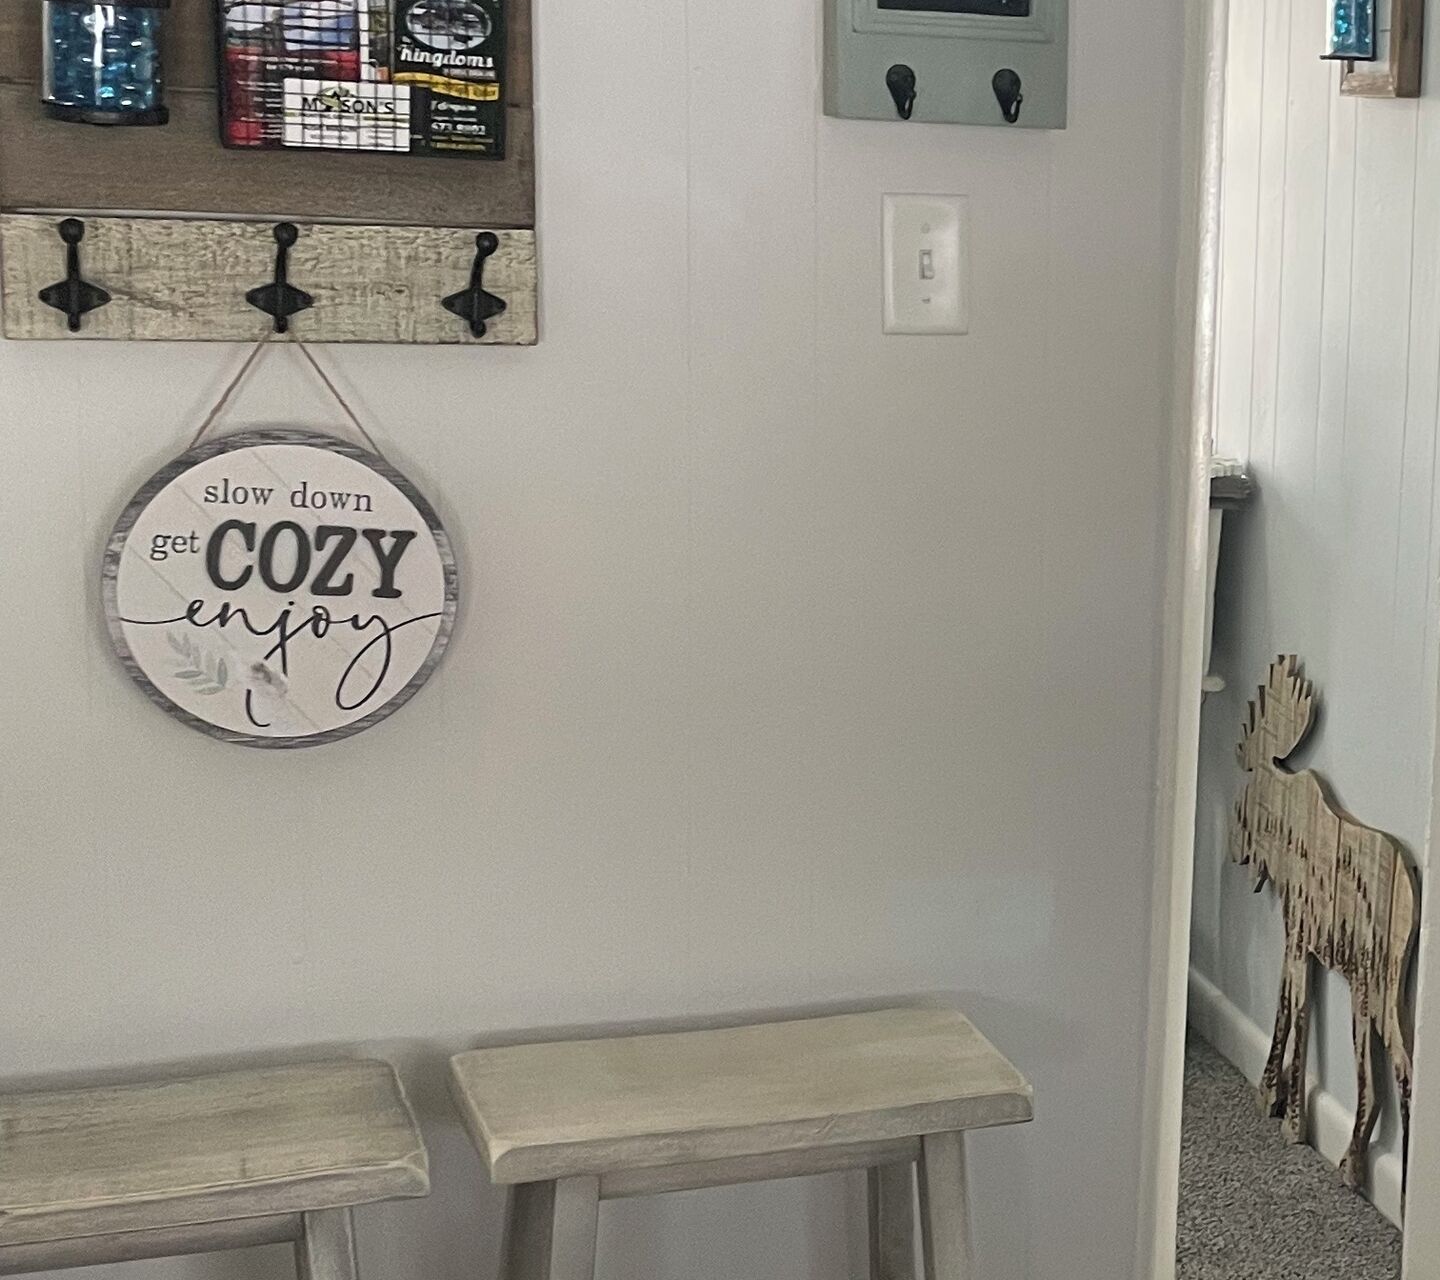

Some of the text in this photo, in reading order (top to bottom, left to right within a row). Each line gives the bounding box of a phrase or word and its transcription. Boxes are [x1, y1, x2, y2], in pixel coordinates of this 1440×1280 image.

[204, 478, 373, 512] slow down
[150, 519, 417, 598] get COZY
[120, 600, 443, 714] enjoy
